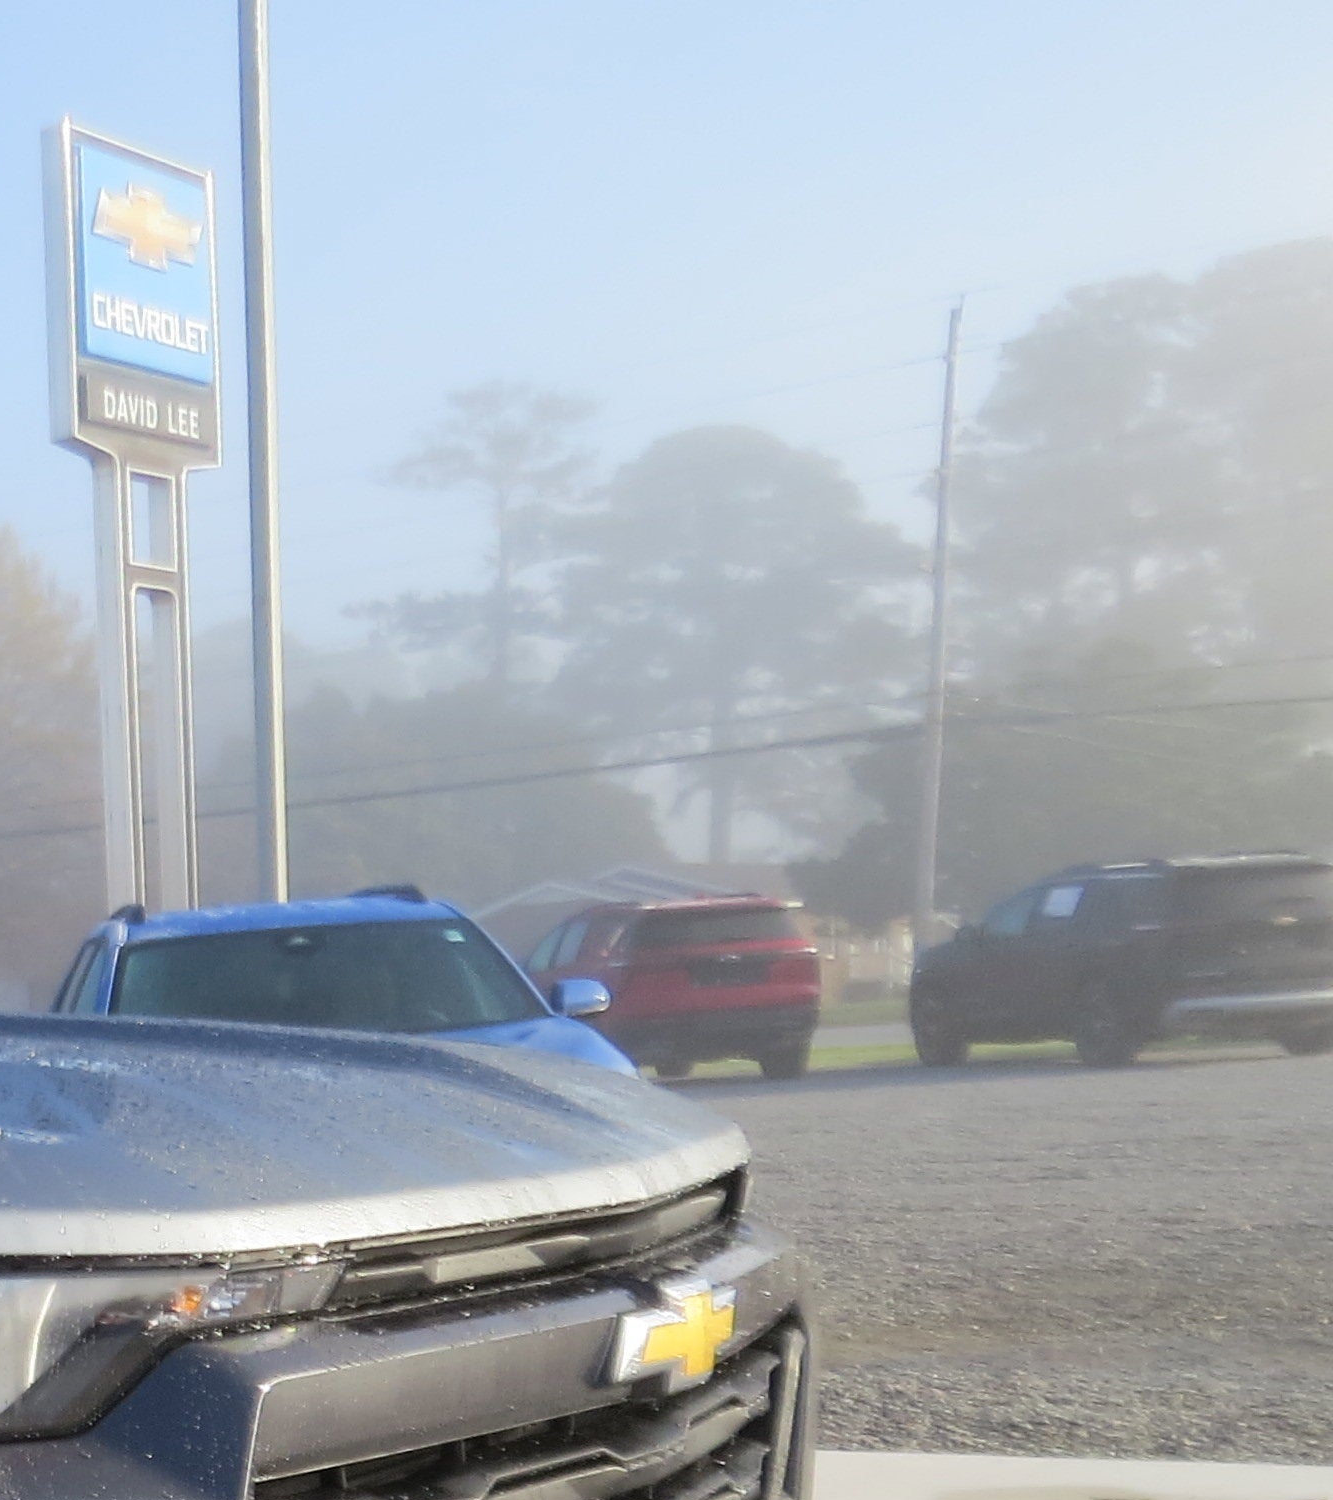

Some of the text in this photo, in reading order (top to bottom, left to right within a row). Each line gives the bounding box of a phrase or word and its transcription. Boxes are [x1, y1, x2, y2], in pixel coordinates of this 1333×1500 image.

[92, 292, 208, 354] CHEVROLET
[103, 387, 200, 440] DAVID LEE
